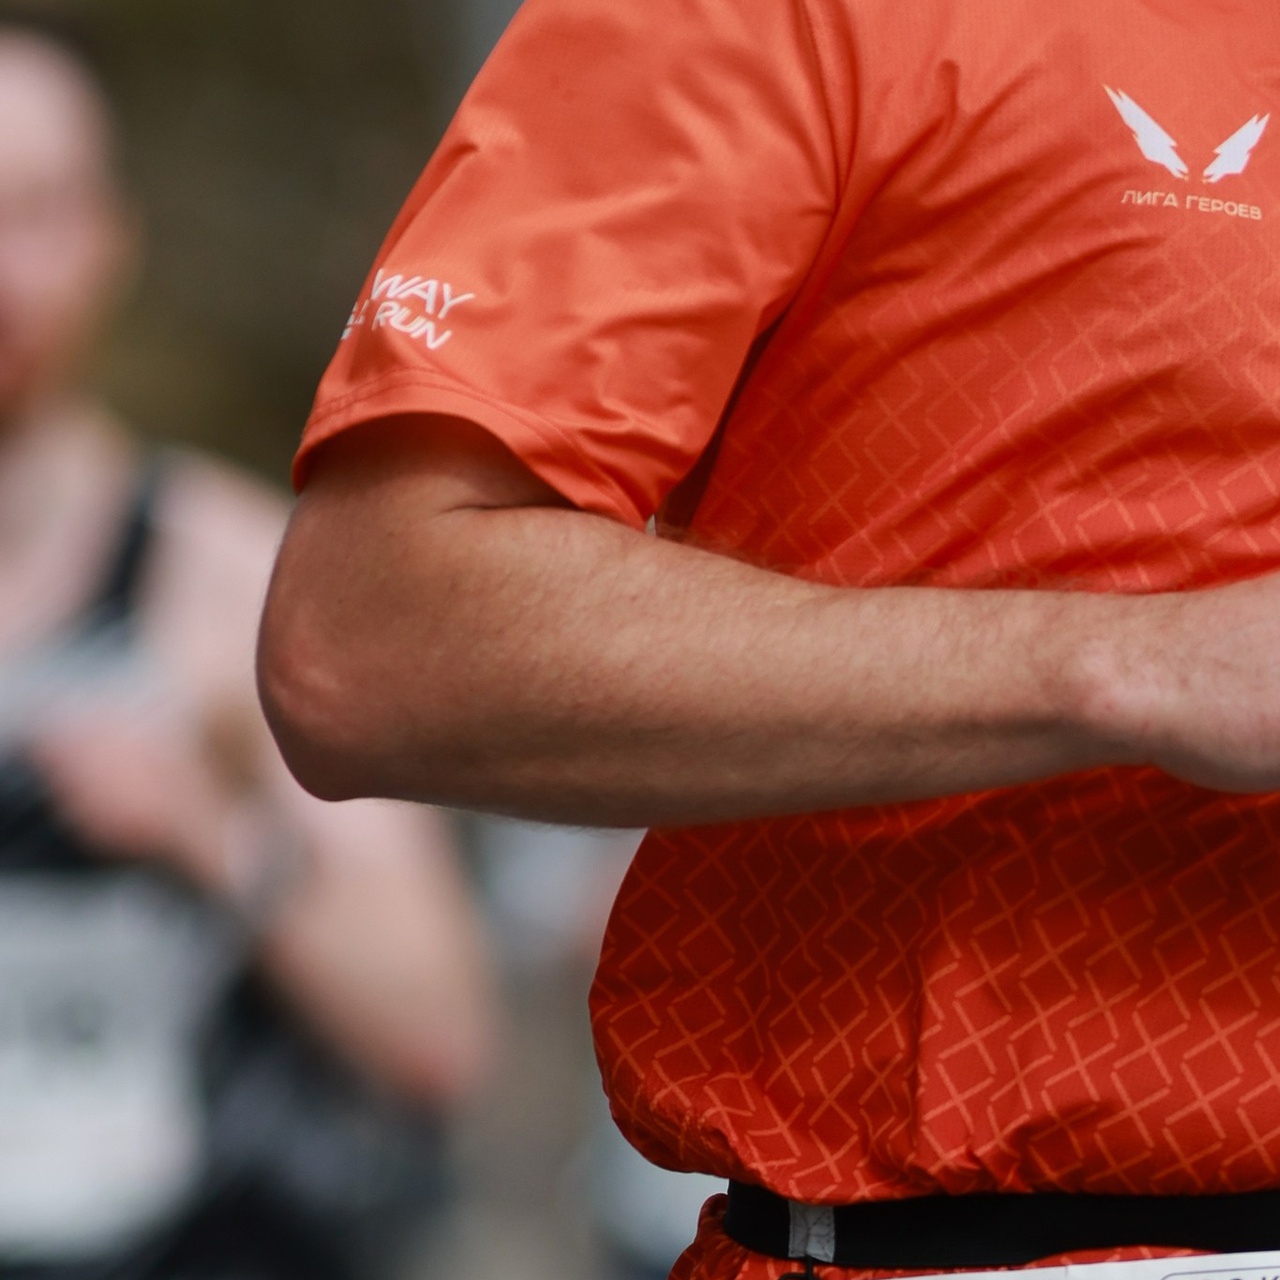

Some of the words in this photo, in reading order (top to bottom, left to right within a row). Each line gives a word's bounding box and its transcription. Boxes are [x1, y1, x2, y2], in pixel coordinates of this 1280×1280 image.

[1121, 189, 1178, 208] ЛИГА
[1185, 195, 1262, 221] ГЕРОЕВ
[371, 268, 475, 319] WAY
[372, 300, 452, 350] RUN
